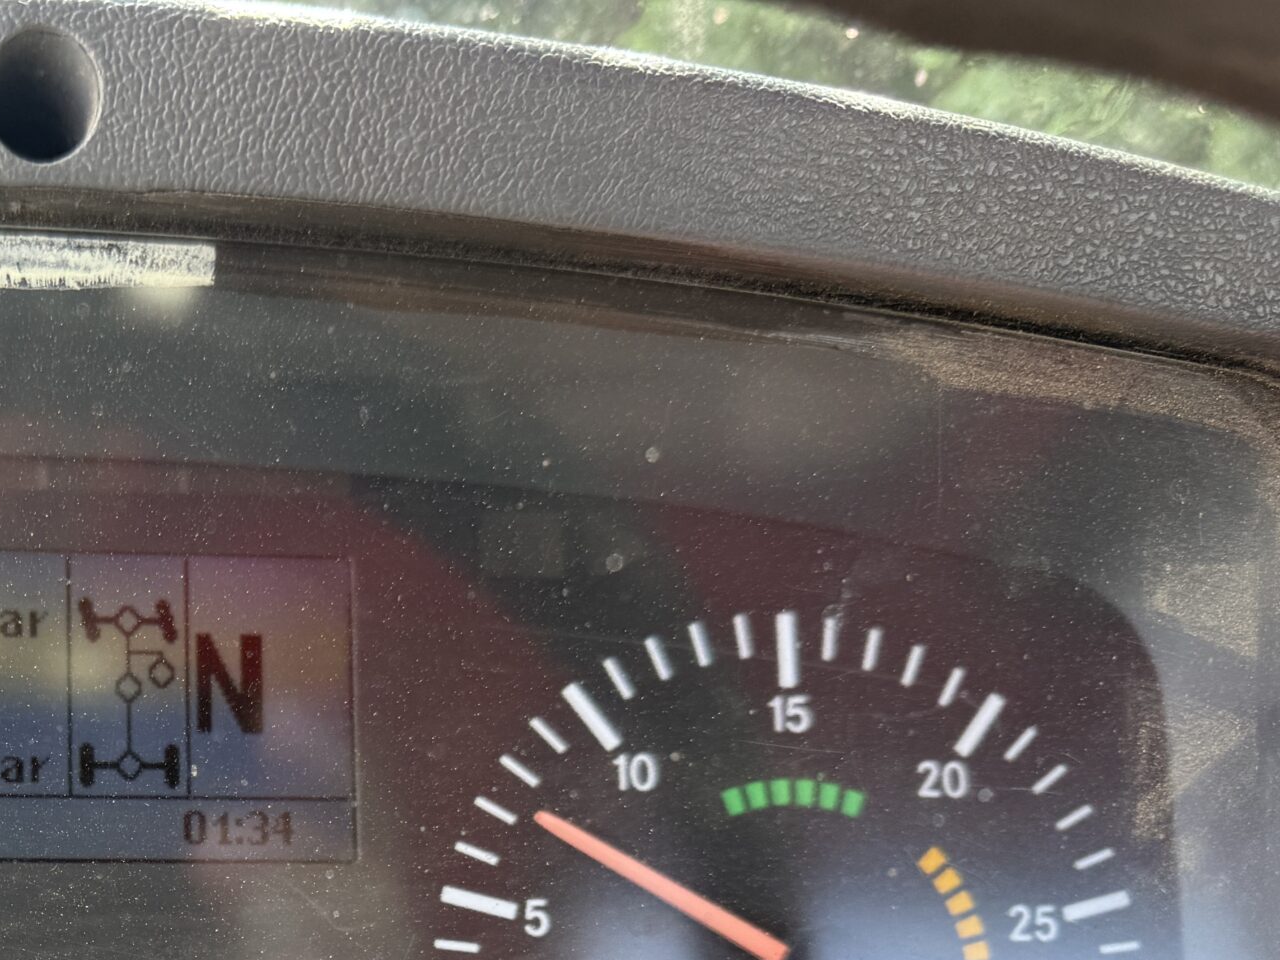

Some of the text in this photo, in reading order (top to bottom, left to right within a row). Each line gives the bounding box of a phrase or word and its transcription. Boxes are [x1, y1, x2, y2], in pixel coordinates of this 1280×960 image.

[195, 632, 263, 734] N
[768, 696, 812, 733] 15
[613, 753, 658, 792] 10
[916, 761, 968, 799] 20
[523, 900, 551, 938] 5
[1008, 906, 1059, 942] 25
